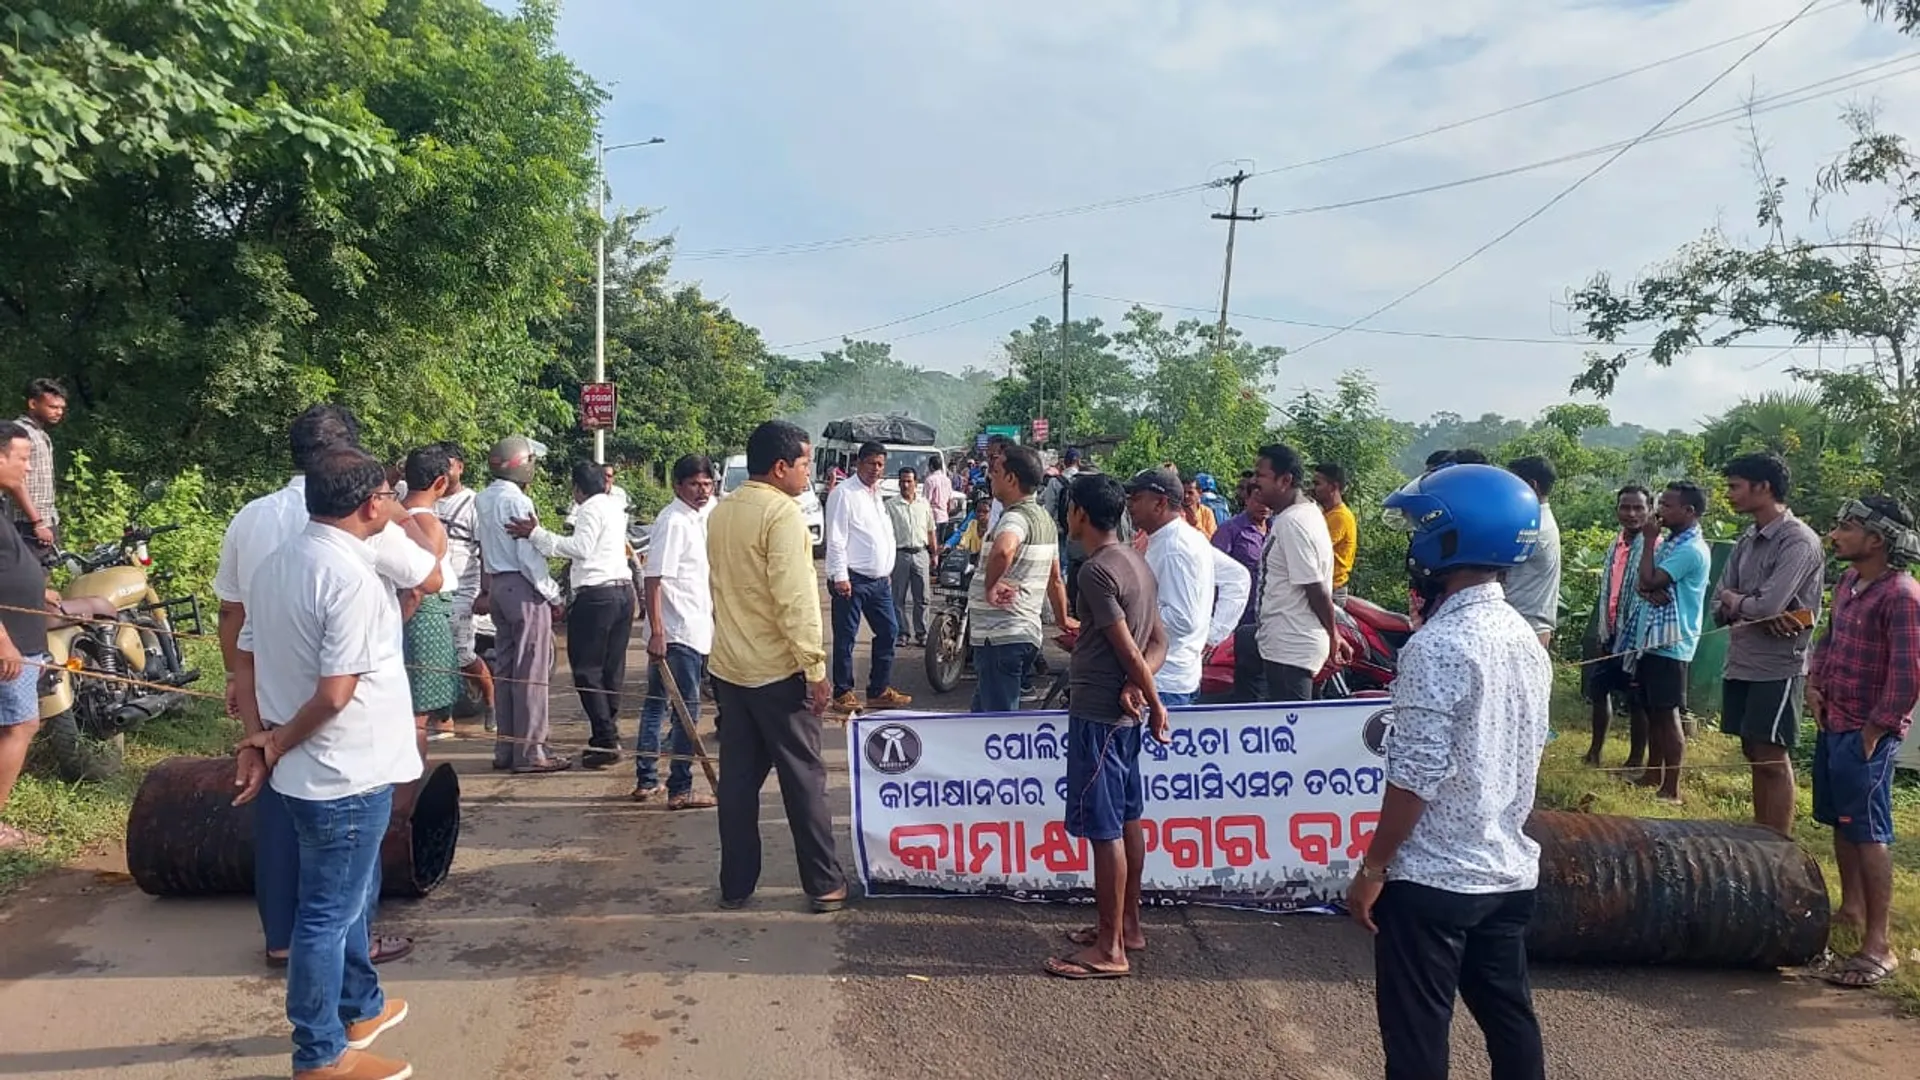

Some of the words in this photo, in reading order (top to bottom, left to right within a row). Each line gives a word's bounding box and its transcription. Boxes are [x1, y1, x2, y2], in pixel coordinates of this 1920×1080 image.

[1240, 712, 1298, 754] ପାଇଁ
[879, 777, 1045, 809] କାମାକ୍ଷାନଗର
[1144, 762, 1293, 801] ସୋସିଏସନ
[1303, 766, 1384, 796] ତରଫ
